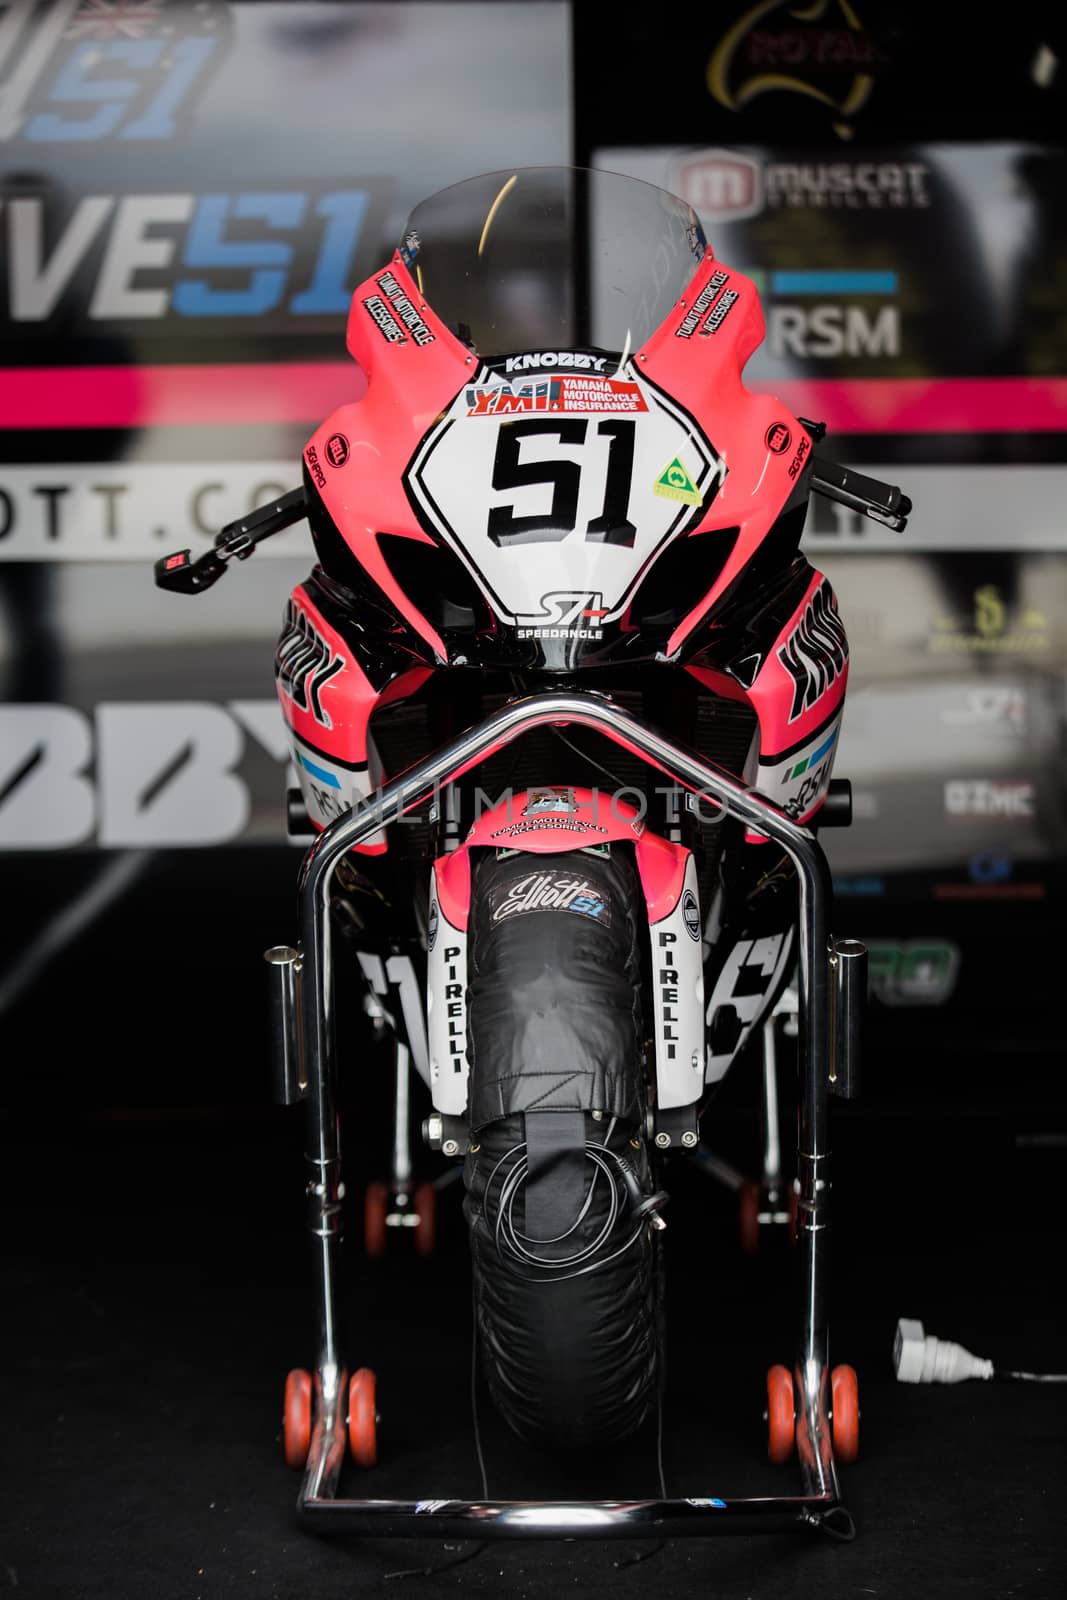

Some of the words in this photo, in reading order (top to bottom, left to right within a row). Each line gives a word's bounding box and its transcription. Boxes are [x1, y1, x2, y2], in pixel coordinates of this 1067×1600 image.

[768, 306, 898, 357] RSM
[505, 352, 607, 372] KNOBBY
[562, 378, 612, 392] YAMAHA
[563, 390, 641, 402] MOTORCYCLE
[564, 400, 637, 410] INSURANCE
[487, 418, 637, 549] 51
[517, 629, 603, 640] SPEEDANGLE
[509, 823, 587, 837] ACCESSORIES
[659, 932, 679, 1059] PIRELLI
[444, 946, 464, 1073] PIRELLI
